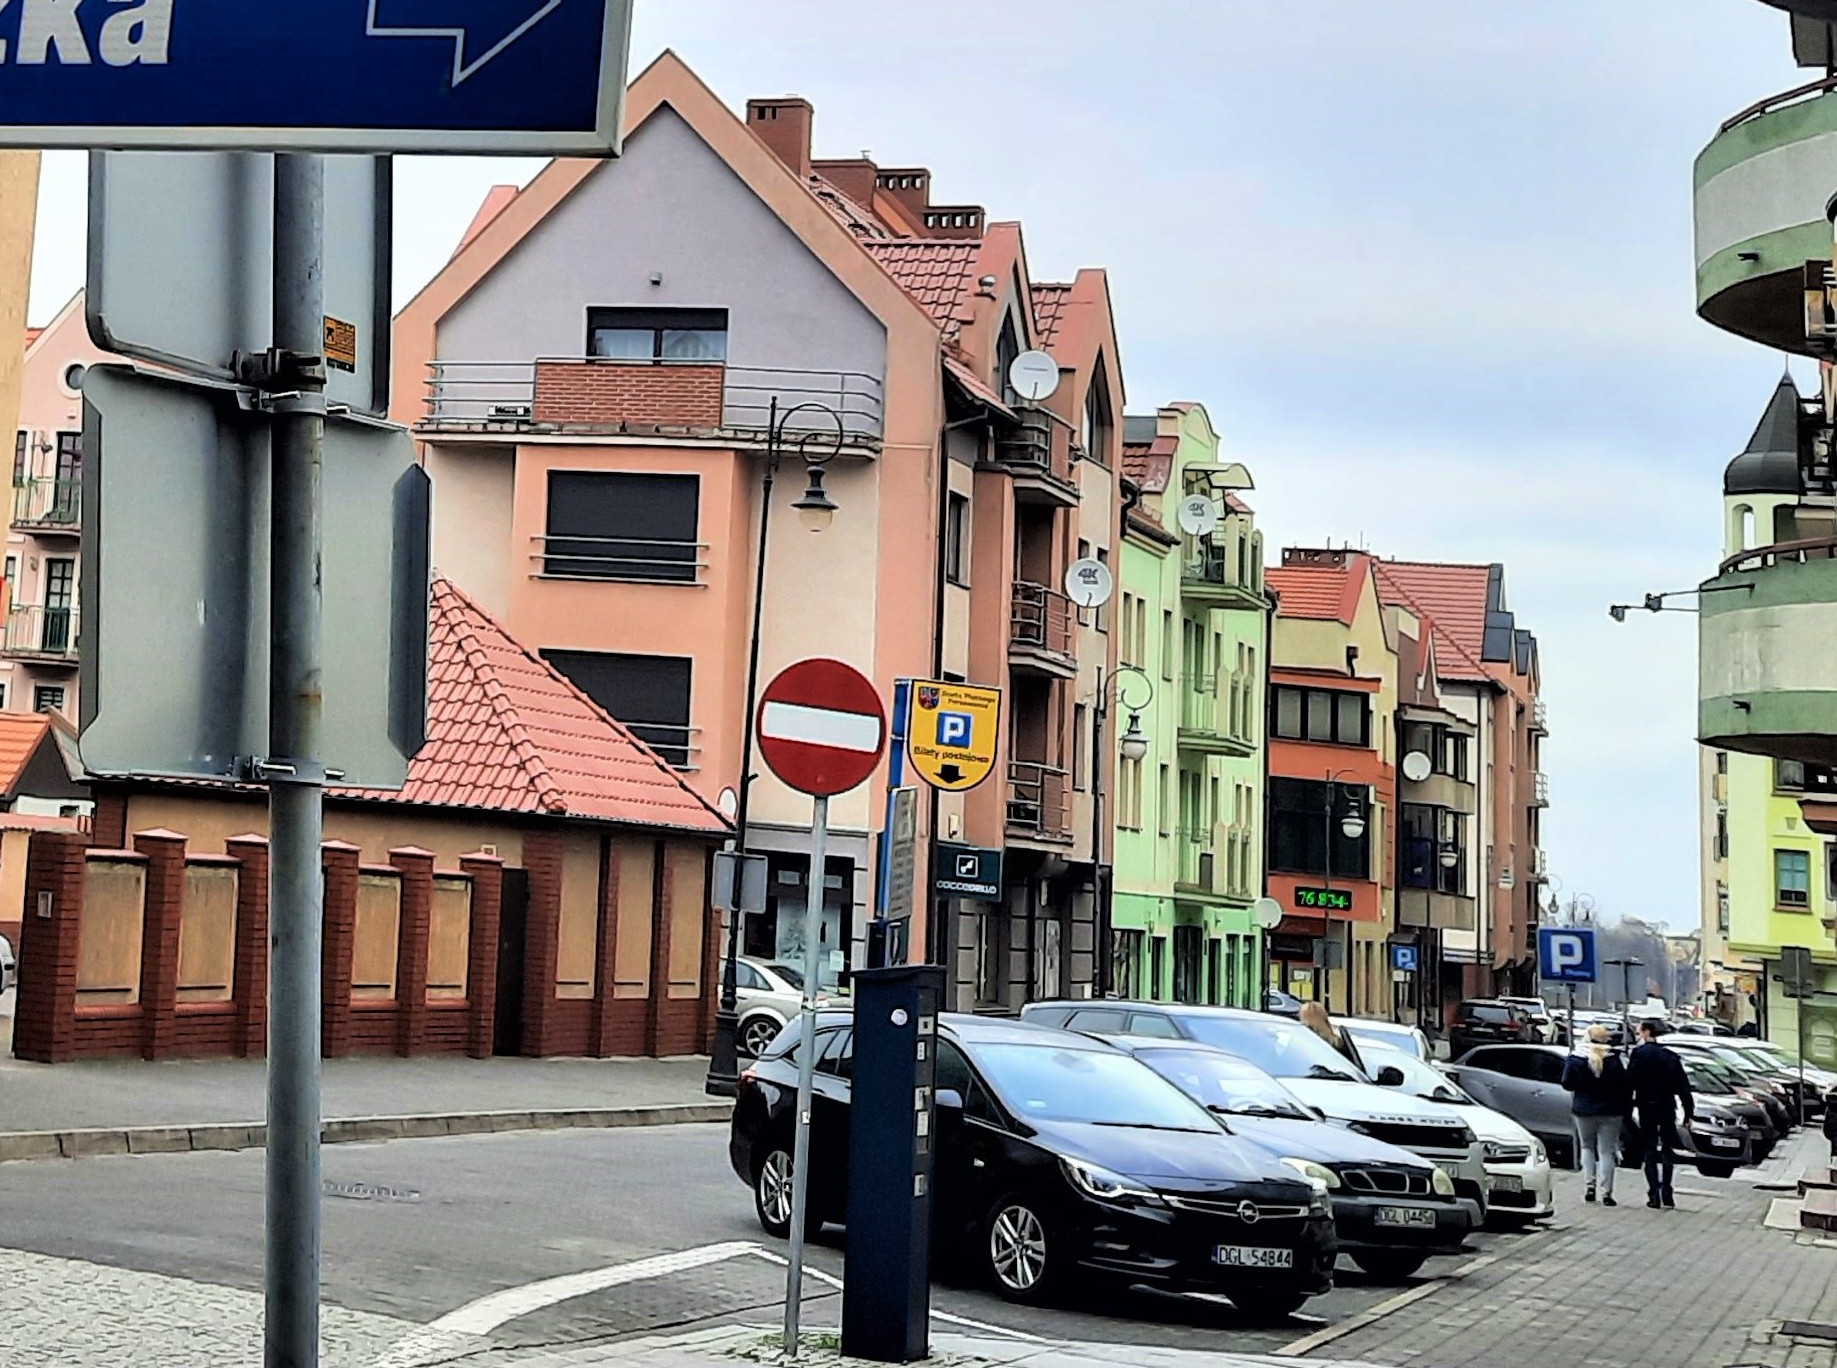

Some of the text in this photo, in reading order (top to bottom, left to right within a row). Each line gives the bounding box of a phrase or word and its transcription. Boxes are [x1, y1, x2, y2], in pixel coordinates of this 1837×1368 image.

[942, 716, 965, 743] P
[1551, 934, 1583, 974] P
[1219, 1246, 1291, 1266] DGL 54844
